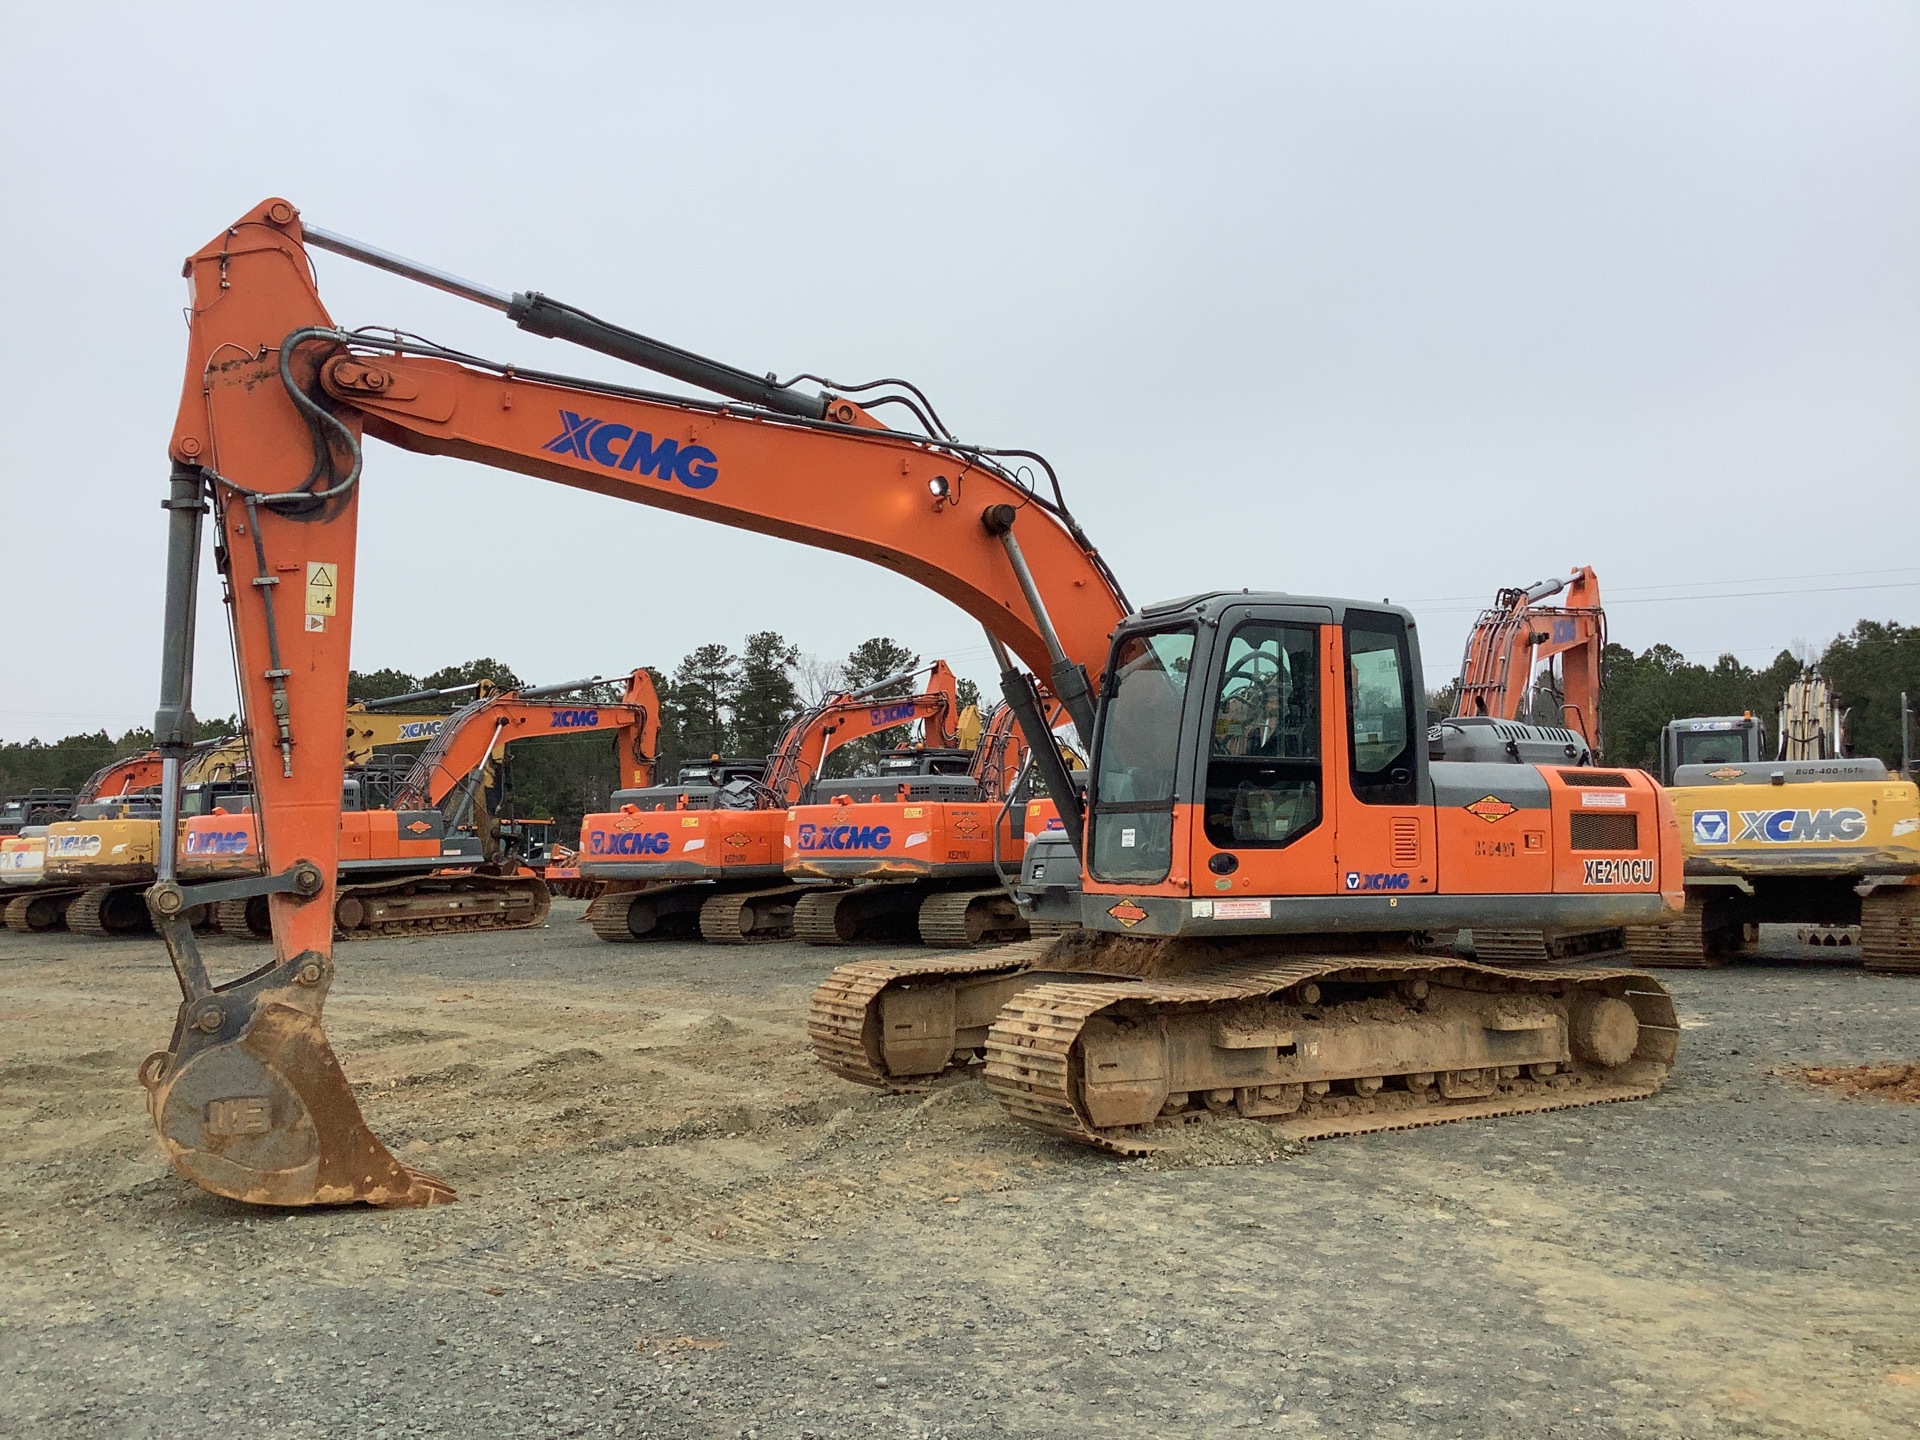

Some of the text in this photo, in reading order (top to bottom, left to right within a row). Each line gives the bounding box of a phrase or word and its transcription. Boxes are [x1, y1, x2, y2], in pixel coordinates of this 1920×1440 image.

[541, 409, 719, 490] XCMG
[398, 720, 444, 740] XCMG
[550, 710, 599, 727] XCMG
[1731, 808, 1868, 844] XCMG
[58, 834, 102, 857] XCMG
[197, 831, 248, 854] XCMG
[606, 832, 671, 855] XCMG
[816, 825, 892, 851] XCMG
[1363, 873, 1410, 890] XCMG
[1584, 859, 1654, 885] XE210CU
